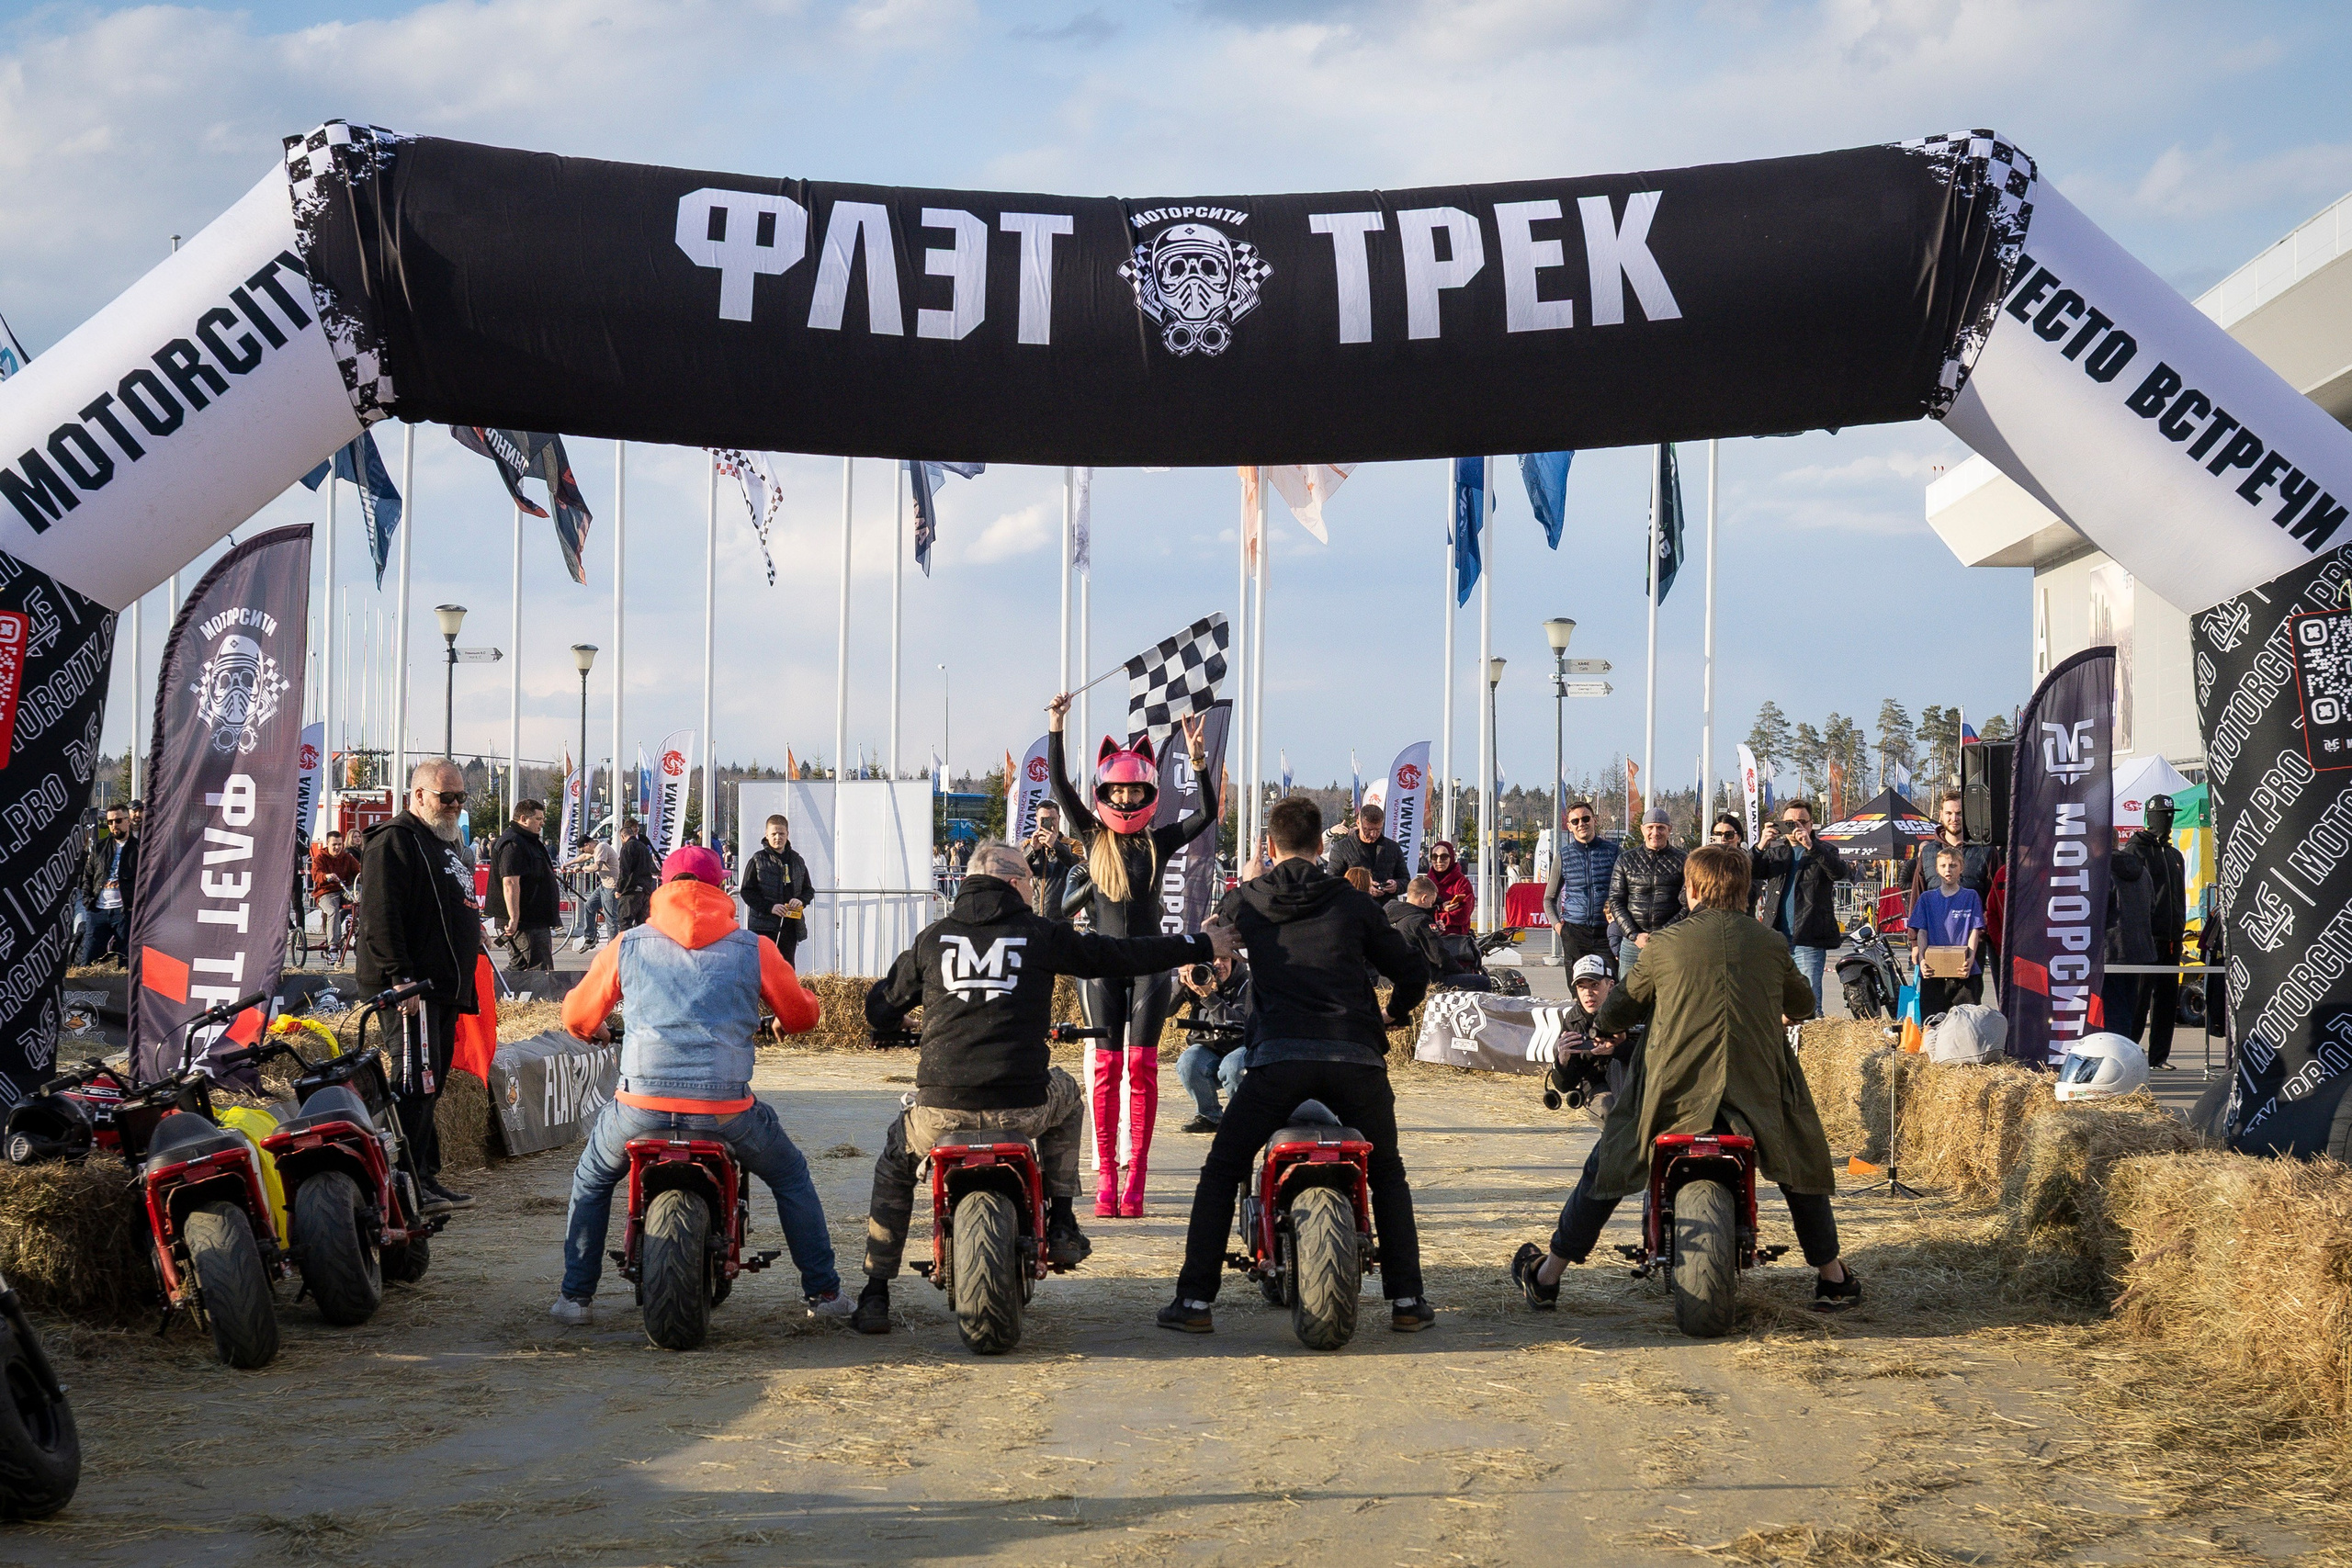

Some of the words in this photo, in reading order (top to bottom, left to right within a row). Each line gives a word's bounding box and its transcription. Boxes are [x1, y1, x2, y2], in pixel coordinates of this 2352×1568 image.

[675, 187, 1074, 344] ФЛЭТ
[1308, 190, 1683, 344] ТРЕК
[1132, 205, 1250, 229] МОТОРСИТИ
[2124, 361, 2351, 554] ВСТРЕЧИ
[198, 607, 278, 641] МОТОРСИТИ
[197, 773, 256, 933] ФЛЭТ
[658, 783, 677, 862] AKAYAMA
